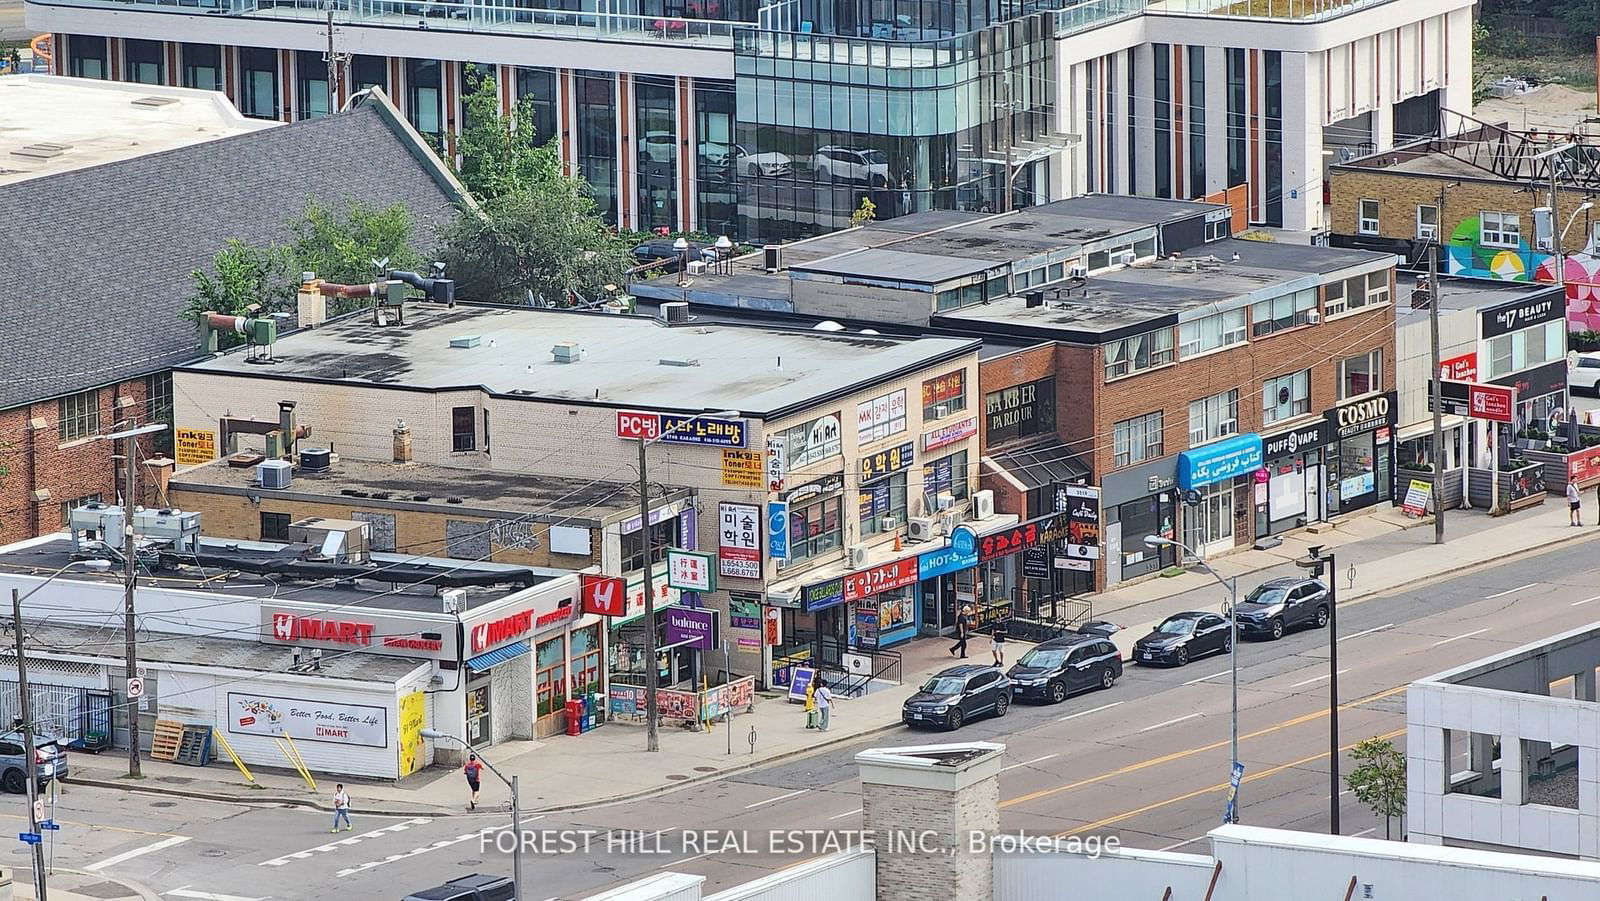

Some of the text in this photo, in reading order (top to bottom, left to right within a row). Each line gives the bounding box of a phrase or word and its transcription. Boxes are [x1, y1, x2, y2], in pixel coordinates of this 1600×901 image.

[1506, 309, 1517, 328] 17
[1519, 300, 1552, 318] BEAUTY
[986, 384, 1036, 415] BARBER
[858, 409, 872, 424] MK
[992, 405, 1033, 430] PARLOUR
[1338, 397, 1389, 427] COSMO
[620, 415, 657, 437] PC방
[696, 421, 741, 444] 노래방
[1341, 425, 1359, 437] BEAUTY
[1267, 441, 1288, 455] PUFF
[1297, 430, 1319, 446] VAPE
[724, 513, 756, 531] 미술
[723, 530, 755, 547] 학원
[593, 582, 614, 611] H
[275, 615, 376, 646] H MART
[474, 623, 489, 651] H
[487, 608, 535, 648] MART
[671, 615, 709, 631] balance
[290, 708, 378, 725] Better Food, Better Life
[325, 729, 348, 738] MART
